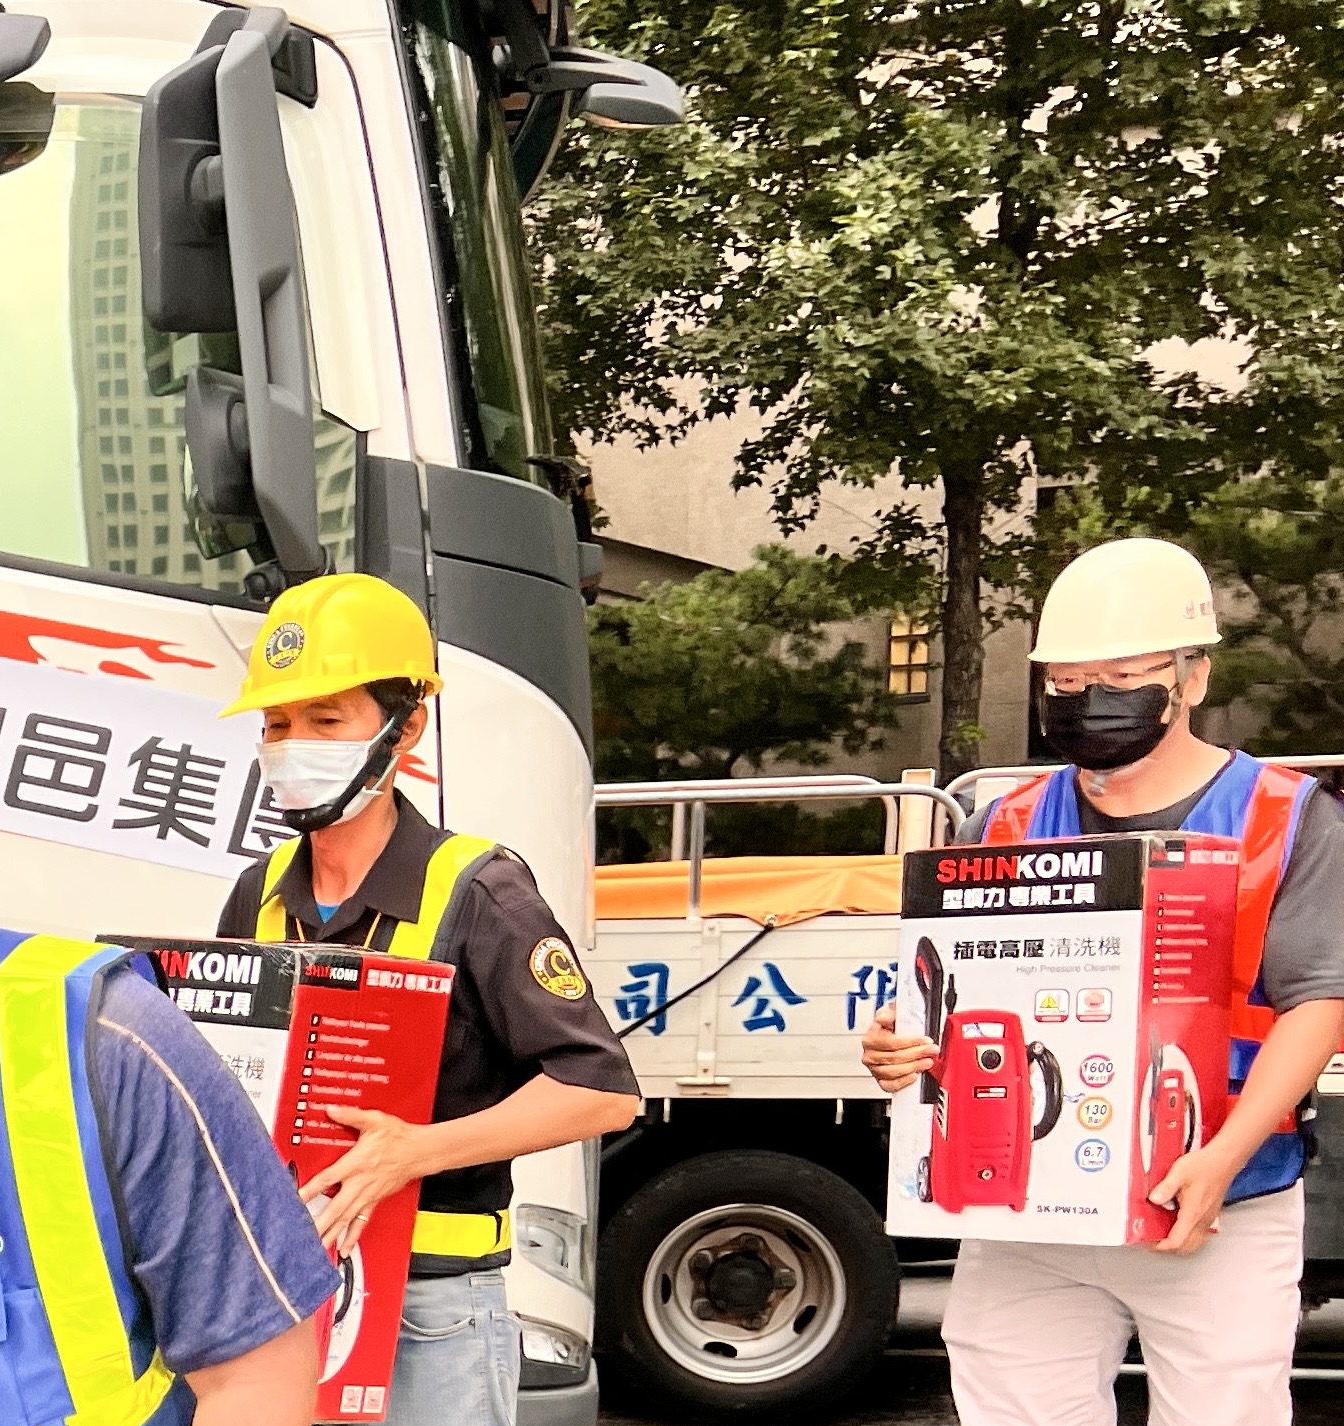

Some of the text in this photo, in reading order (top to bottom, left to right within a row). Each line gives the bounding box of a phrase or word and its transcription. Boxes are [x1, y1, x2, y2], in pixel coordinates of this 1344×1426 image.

[936, 850, 1103, 884] SHINKOMI
[159, 950, 261, 986] INKOMI
[217, 1054, 266, 1081] 洗機
[1082, 1062, 1114, 1074] 1600
[1085, 1104, 1107, 1116] 130
